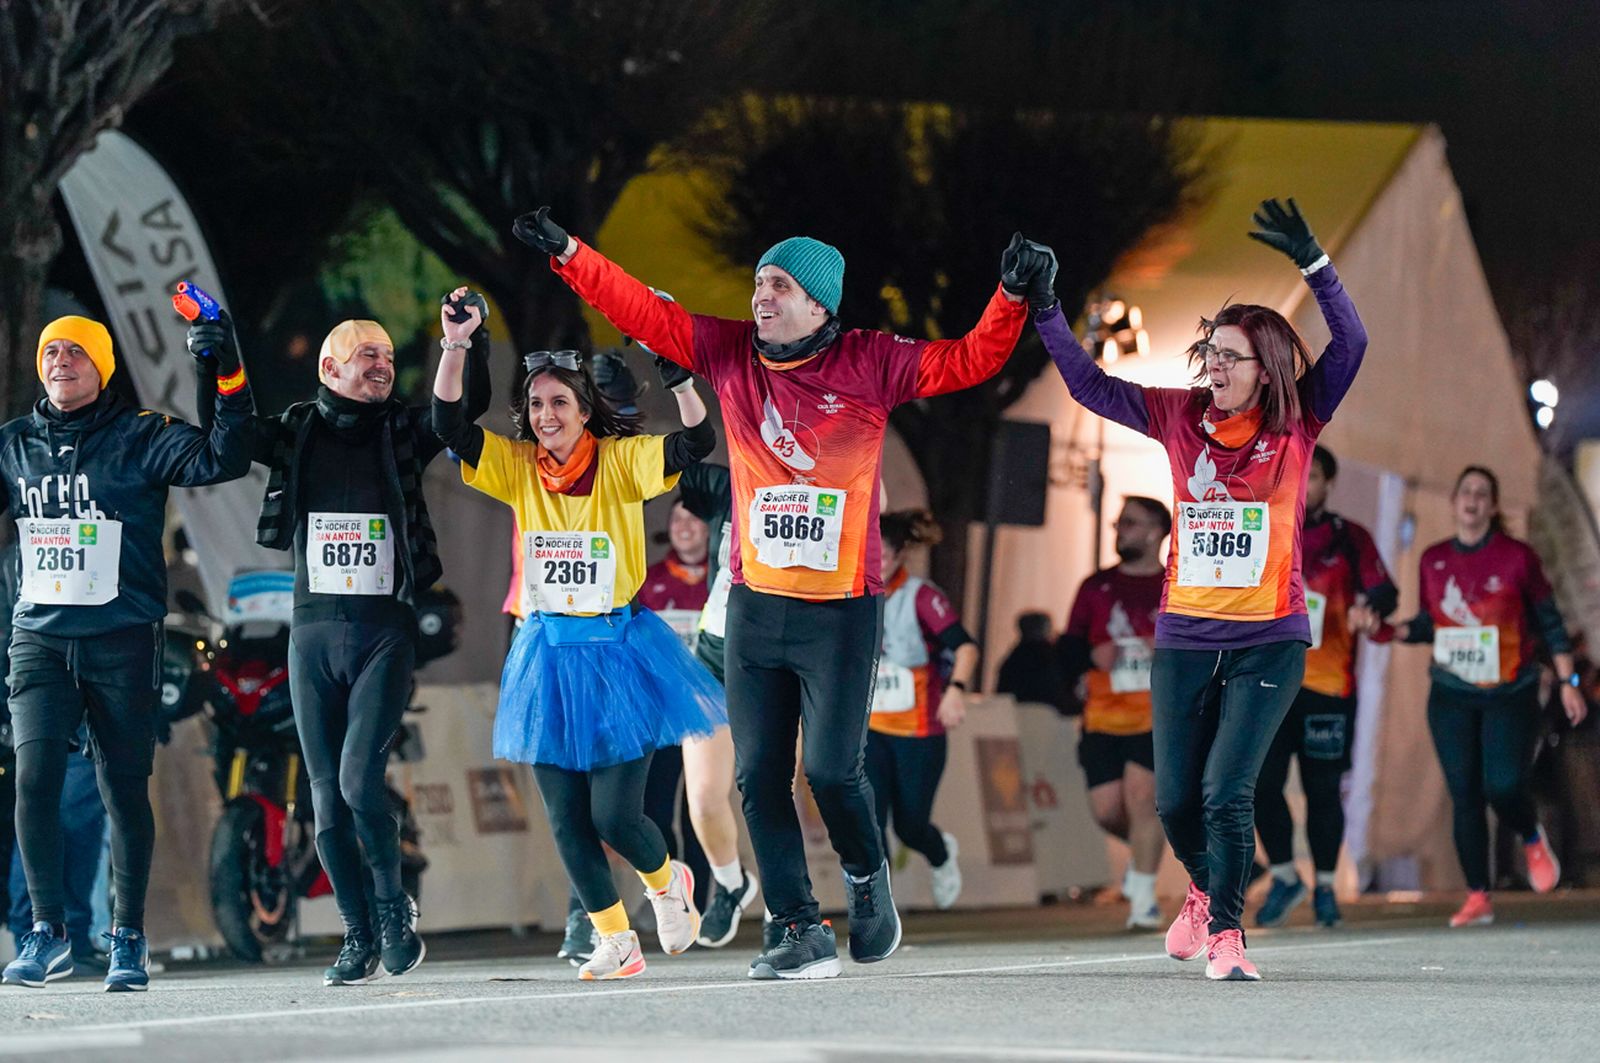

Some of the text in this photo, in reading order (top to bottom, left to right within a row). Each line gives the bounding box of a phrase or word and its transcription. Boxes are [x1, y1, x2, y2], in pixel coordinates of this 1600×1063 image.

[773, 436, 796, 458] 43
[773, 494, 798, 503] NOCHE
[798, 495, 810, 503] DE
[760, 503, 778, 513] SAN
[778, 502, 809, 513] ANTÓN
[1224, 511, 1235, 519] DE
[60, 526, 71, 534] DE
[324, 522, 349, 530] NOCHE
[351, 522, 362, 530] DE
[764, 514, 825, 542] 5868
[1188, 521, 1205, 530] SAN
[31, 536, 42, 545] SAN
[332, 530, 362, 541] ANTÓN
[545, 540, 572, 548] NOCHE
[573, 540, 583, 548] DE
[1192, 532, 1252, 557] 5869
[36, 547, 86, 571] 2361
[322, 543, 377, 567] 6873
[535, 550, 553, 559] SAN
[554, 549, 583, 559] ANTÓN
[544, 560, 598, 585] 2361
